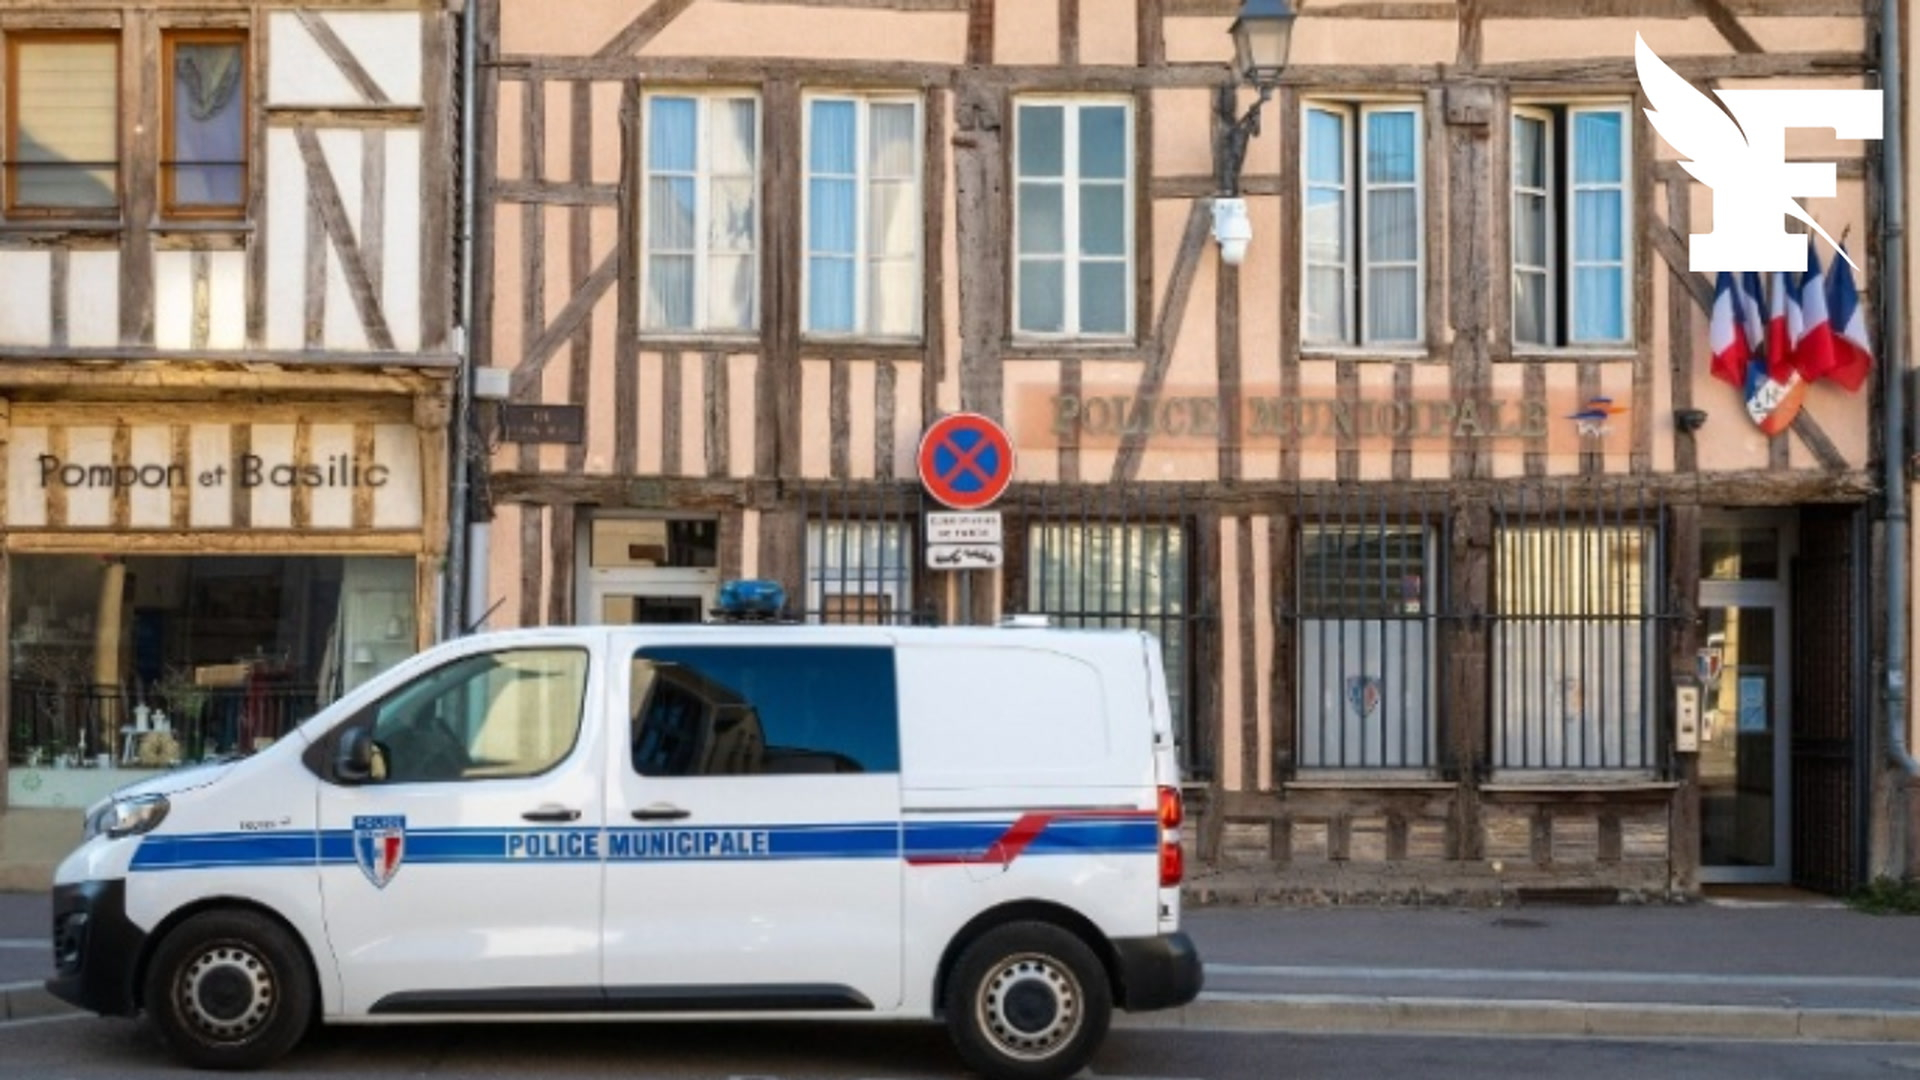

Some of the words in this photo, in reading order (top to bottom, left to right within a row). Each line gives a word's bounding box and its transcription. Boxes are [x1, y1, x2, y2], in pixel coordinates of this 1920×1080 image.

[1051, 395, 1220, 436] POLICE
[1247, 397, 1547, 438] MUNICIPALE
[38, 453, 187, 498] Pompon
[198, 463, 226, 487] et
[240, 453, 390, 488] Basilic
[507, 833, 599, 858] POLICE
[608, 830, 766, 857] MUNICIPALE
